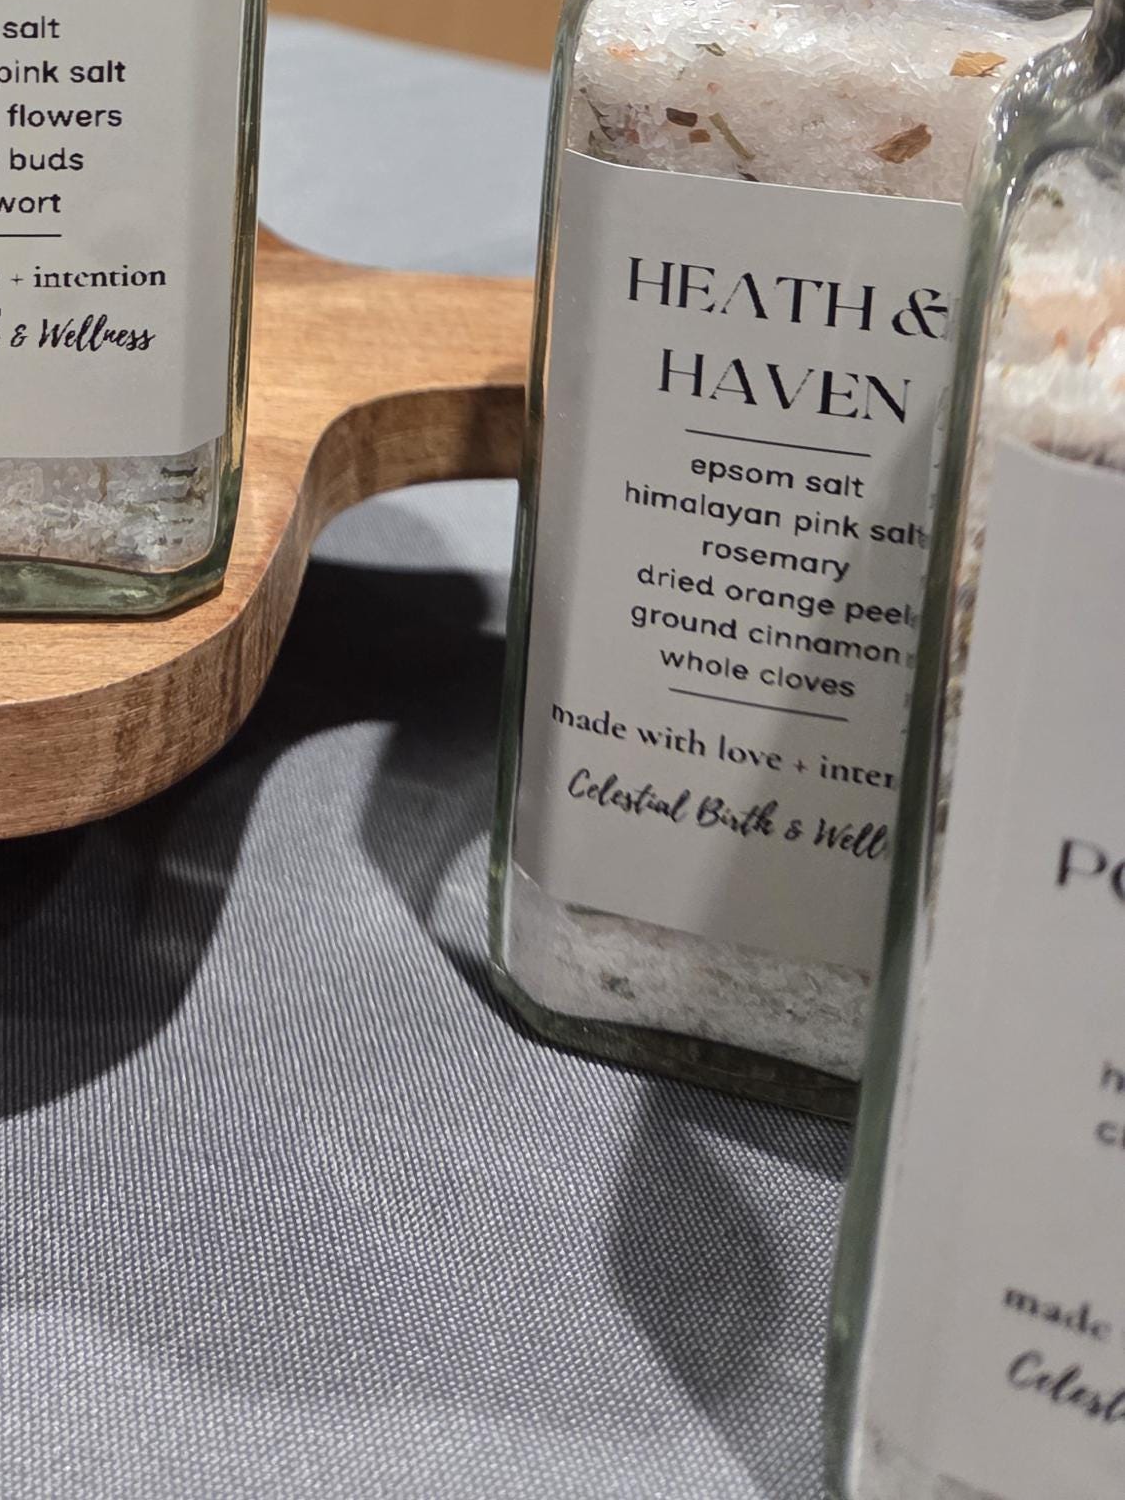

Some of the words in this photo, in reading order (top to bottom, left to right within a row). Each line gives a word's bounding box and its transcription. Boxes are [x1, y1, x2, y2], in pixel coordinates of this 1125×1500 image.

[2, 15, 60, 39] salt
[69, 59, 126, 84] salt
[6, 103, 123, 128] flowers
[9, 147, 84, 172] buds
[33, 264, 167, 288] intention
[628, 256, 876, 332] HEATH
[891, 288, 948, 339] &
[10, 323, 28, 348] &
[38, 313, 156, 353] Wellness
[658, 348, 911, 424] HAVEN
[690, 458, 794, 489] epsom
[805, 474, 865, 499] salt
[625, 481, 781, 528] himalayan
[794, 511, 860, 540] pink
[870, 522, 927, 549] salt
[701, 539, 851, 582] rosemary
[637, 564, 715, 597] dried
[725, 583, 835, 618] orange
[844, 600, 911, 625] peel
[630, 605, 738, 640] ground
[748, 625, 903, 667] cinnamon
[659, 649, 749, 681] whole
[759, 666, 856, 699] cloves
[550, 702, 627, 740] made
[636, 726, 706, 757] with
[718, 734, 784, 772] love
[567, 767, 691, 824] Celestial
[696, 795, 779, 838] Birth
[1003, 1287, 1112, 1340] made
